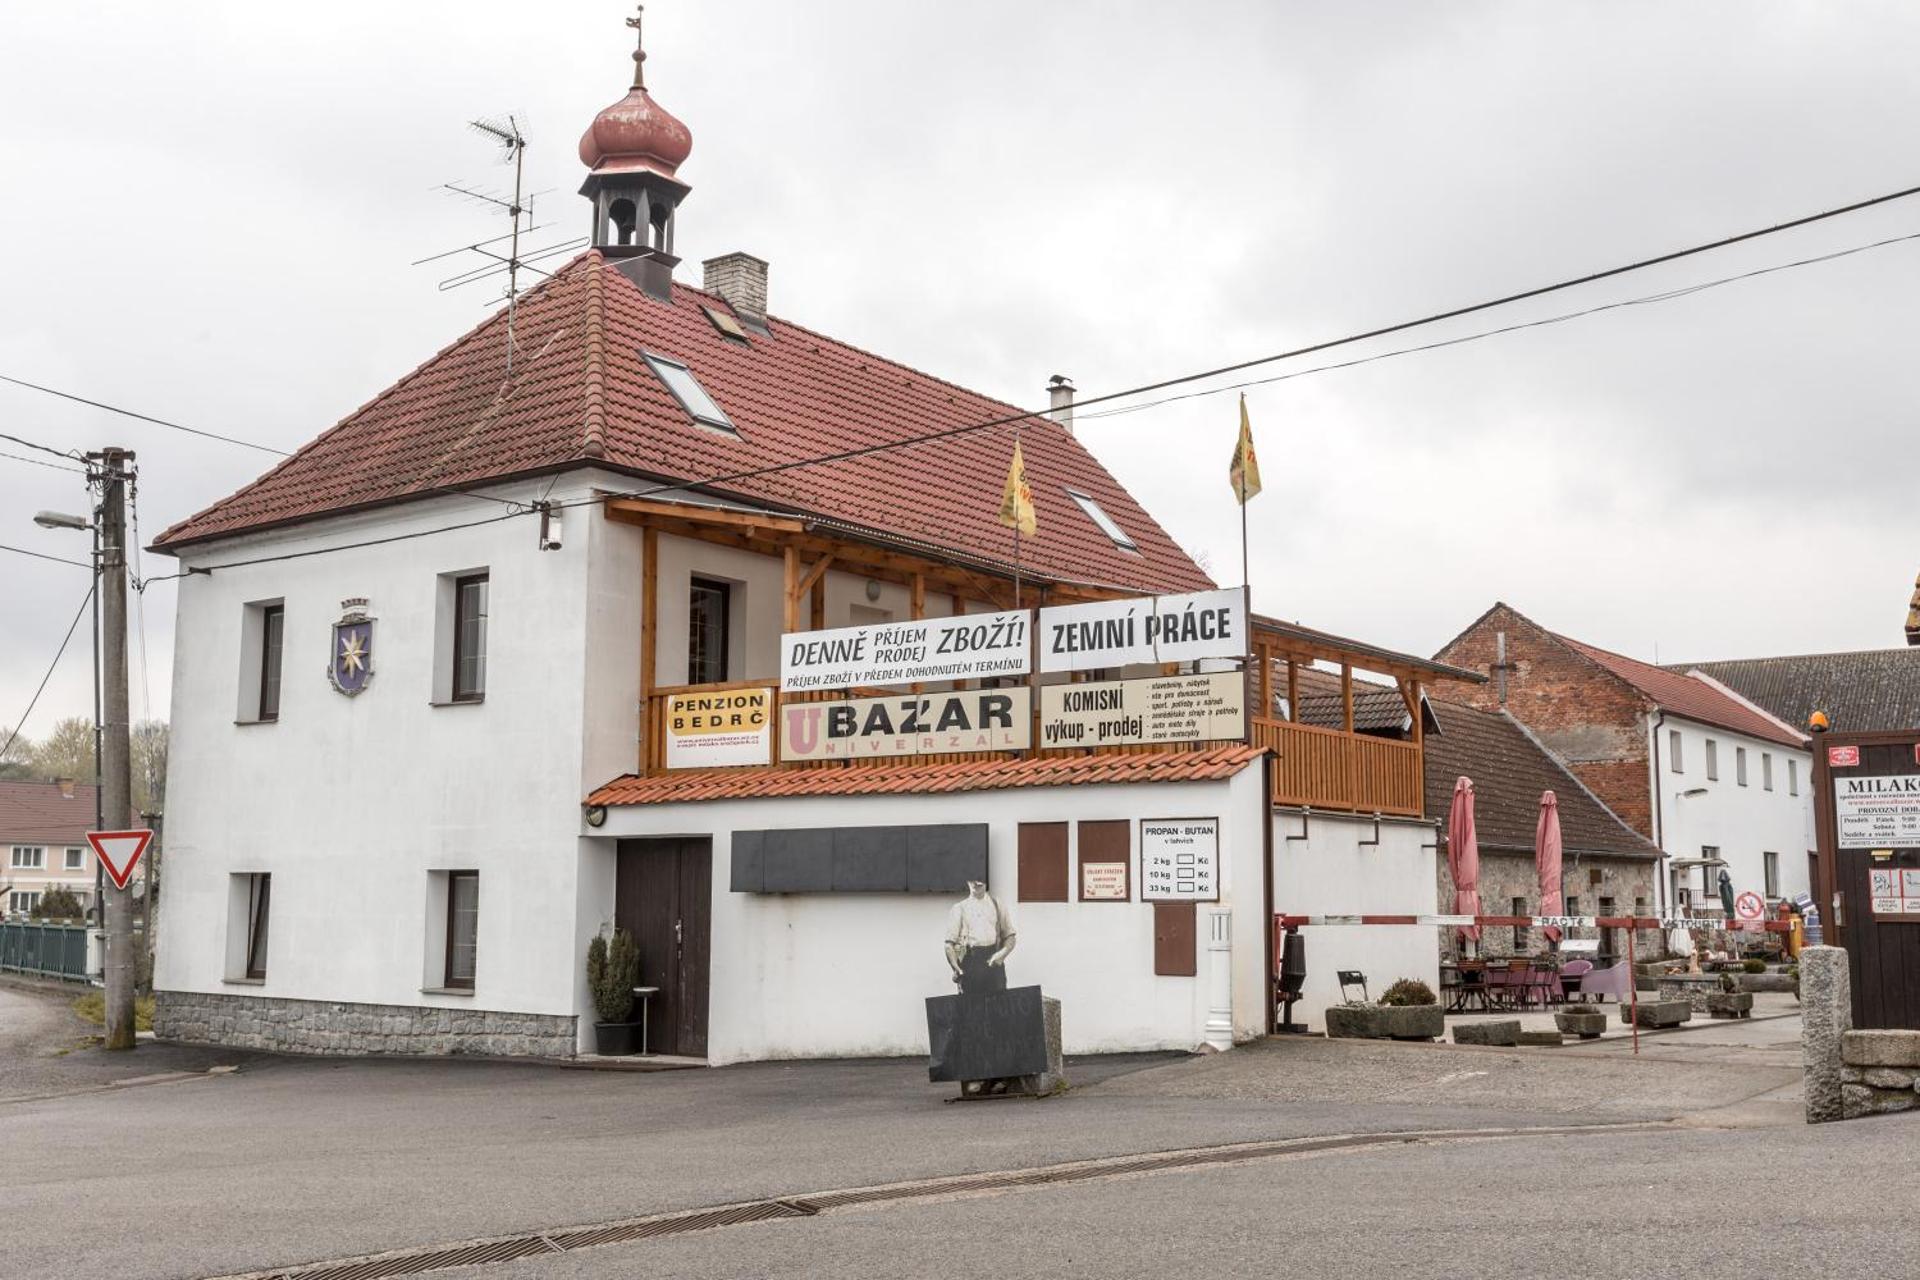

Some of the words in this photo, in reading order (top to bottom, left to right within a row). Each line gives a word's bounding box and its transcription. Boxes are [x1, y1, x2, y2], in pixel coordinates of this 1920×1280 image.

[1052, 607, 1135, 654] ZEMNÍ
[1145, 602, 1231, 645] PRÁCE
[791, 631, 868, 667] DENNĚ
[874, 627, 927, 646] PŘÍJEM
[937, 615, 1025, 654] ZBOŽÍ!
[875, 646, 926, 664] PRODEJ
[787, 675, 821, 687] PŘÍJEM
[822, 670, 851, 684] ZBOŽÍ
[854, 672, 863, 682] V
[863, 666, 903, 682] PŘEDEM
[905, 662, 972, 678] DOHODNUTÉM
[975, 658, 1023, 671] TERMÍNU
[674, 695, 763, 712] PENZION
[1063, 683, 1123, 712] KOMISNÍ
[674, 710, 763, 729] BEDRČ
[828, 694, 1013, 738] BAZAR
[1045, 718, 1084, 743] výkup
[1099, 715, 1143, 741] prodej
[1849, 778, 1920, 793] MILAK
[1858, 806, 1898, 814] PROVOZNÍ
[1145, 827, 1179, 835] PROPAN
[1185, 827, 1213, 835] BUTAN
[1154, 857, 1159, 865] 2
[1160, 857, 1171, 866] kg
[1197, 857, 1209, 865] Kč
[1160, 871, 1171, 880] kg
[1160, 885, 1171, 893] kg
[1197, 884, 1209, 892] Kč
